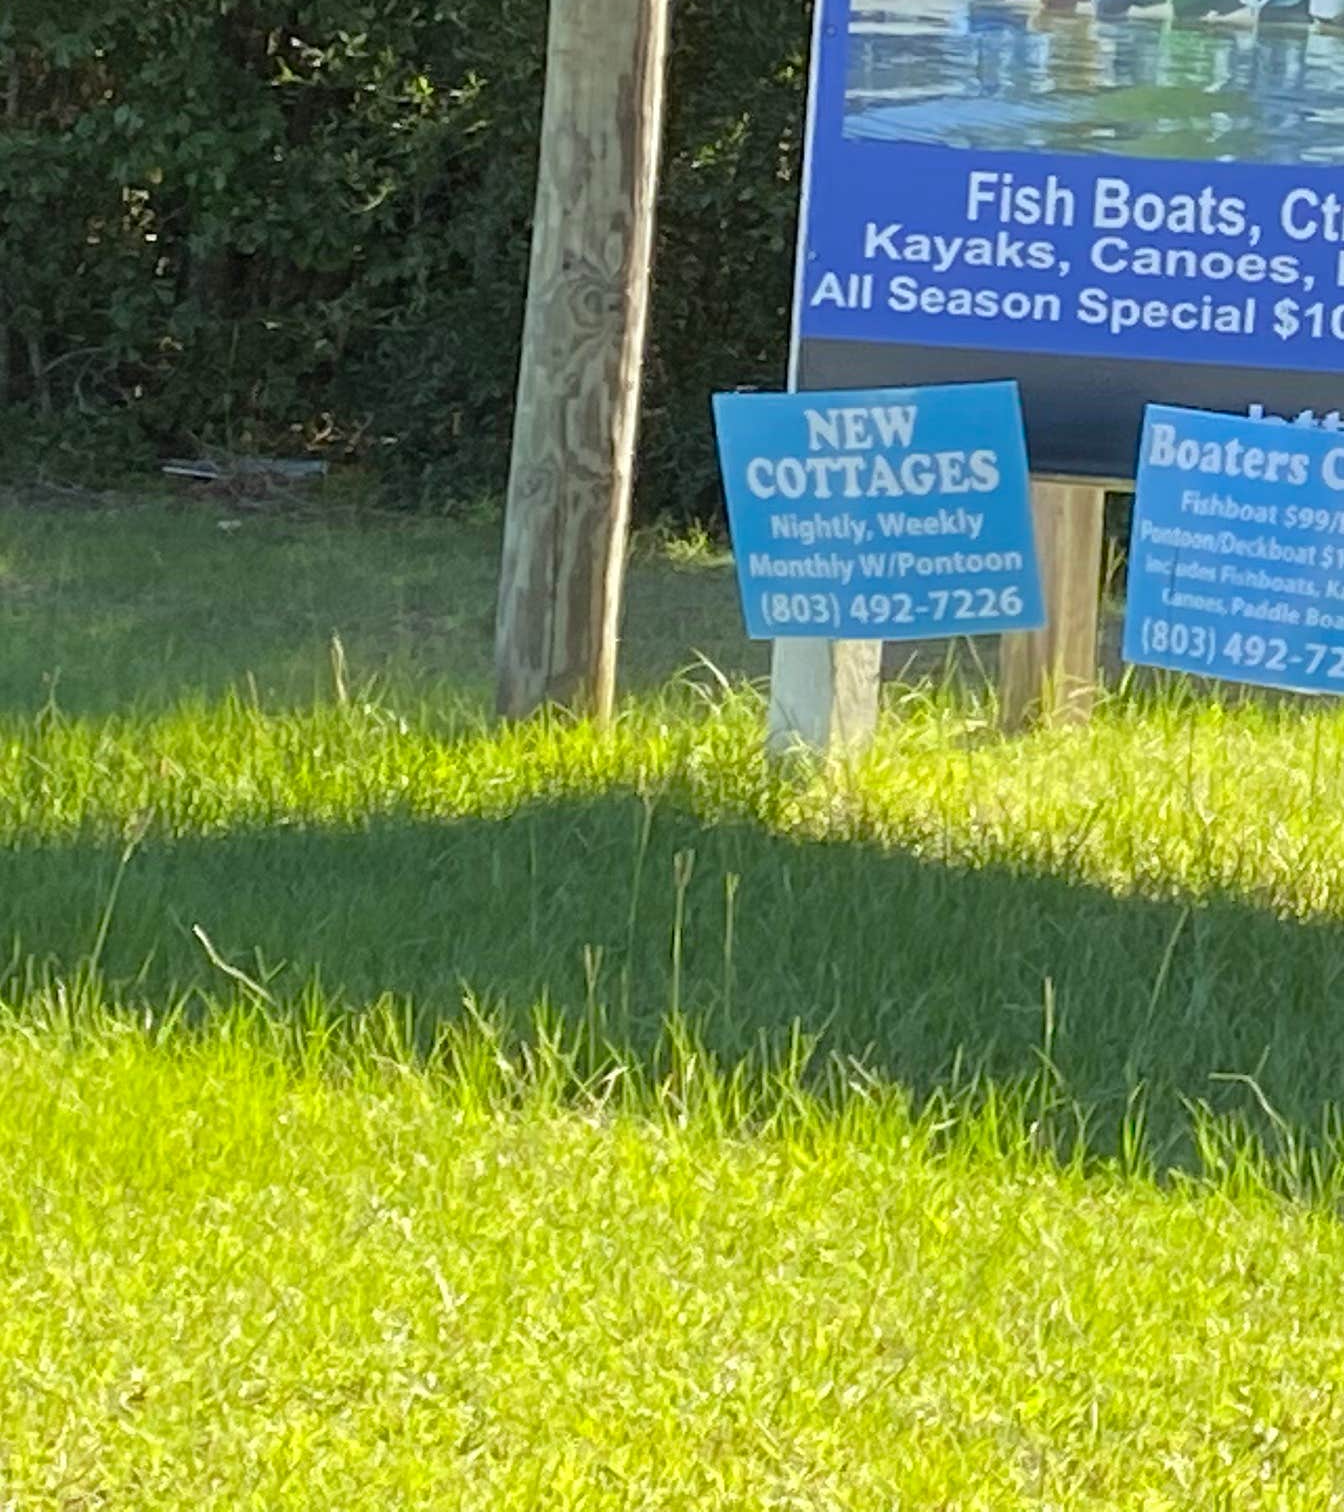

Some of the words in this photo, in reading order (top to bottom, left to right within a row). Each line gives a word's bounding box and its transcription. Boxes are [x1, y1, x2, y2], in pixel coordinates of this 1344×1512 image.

[967, 170, 1074, 227] Fish
[1093, 178, 1262, 246] Boats,
[864, 222, 1071, 277] Kayaks,
[1091, 235, 1316, 292] Canoes,
[810, 271, 873, 309] All
[887, 275, 1061, 322] Season
[1077, 287, 1256, 334] Special
[805, 405, 918, 452] NEW
[746, 449, 1000, 499] COTTAGES
[1149, 423, 1311, 486] Boaters
[771, 513, 873, 546] Nightly,
[877, 507, 984, 540] Weekly
[1180, 489, 1279, 524] Fishboat
[750, 551, 855, 587] Monthly
[860, 550, 1023, 579] W/Pontoon
[760, 592, 841, 629] (803)
[850, 585, 1024, 625] 492-7226
[1231, 596, 1300, 626] Paddle
[1141, 617, 1217, 664] (803)
